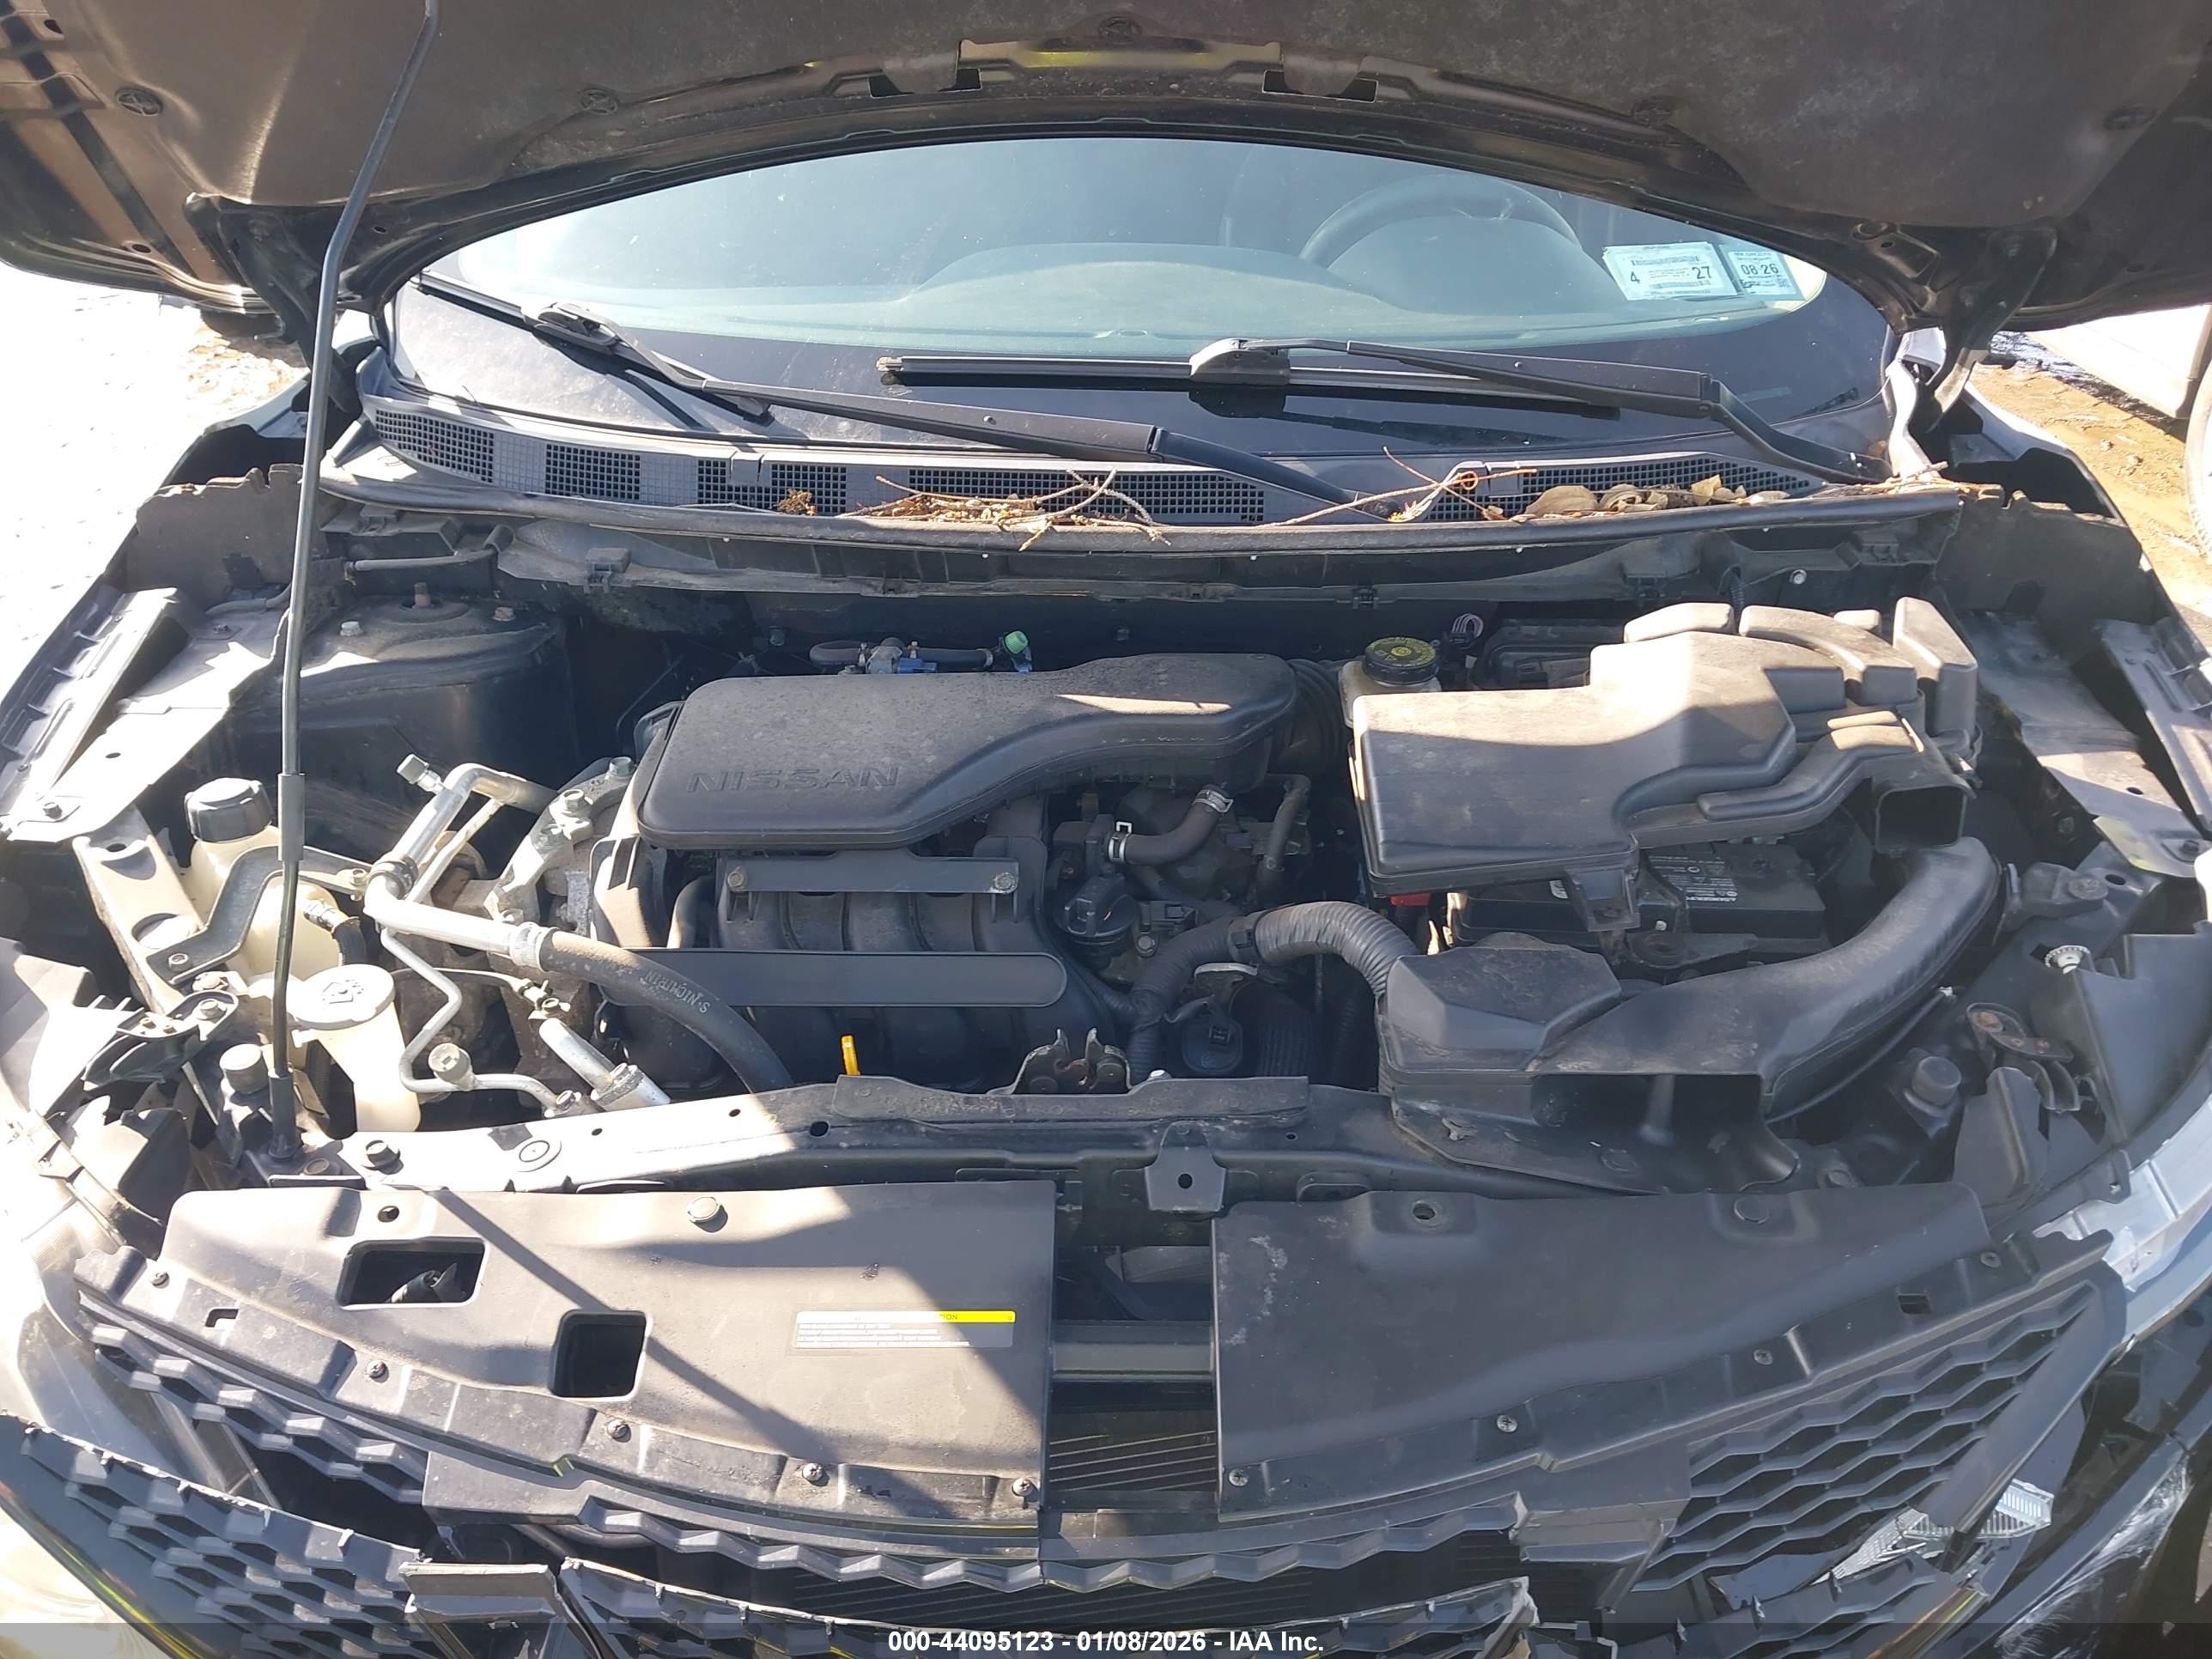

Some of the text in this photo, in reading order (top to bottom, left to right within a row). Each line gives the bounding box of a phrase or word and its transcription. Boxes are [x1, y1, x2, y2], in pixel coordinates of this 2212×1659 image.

[1630, 270, 1641, 284] 4
[1692, 265, 1712, 280] 27
[689, 767, 900, 793] NISSAN
